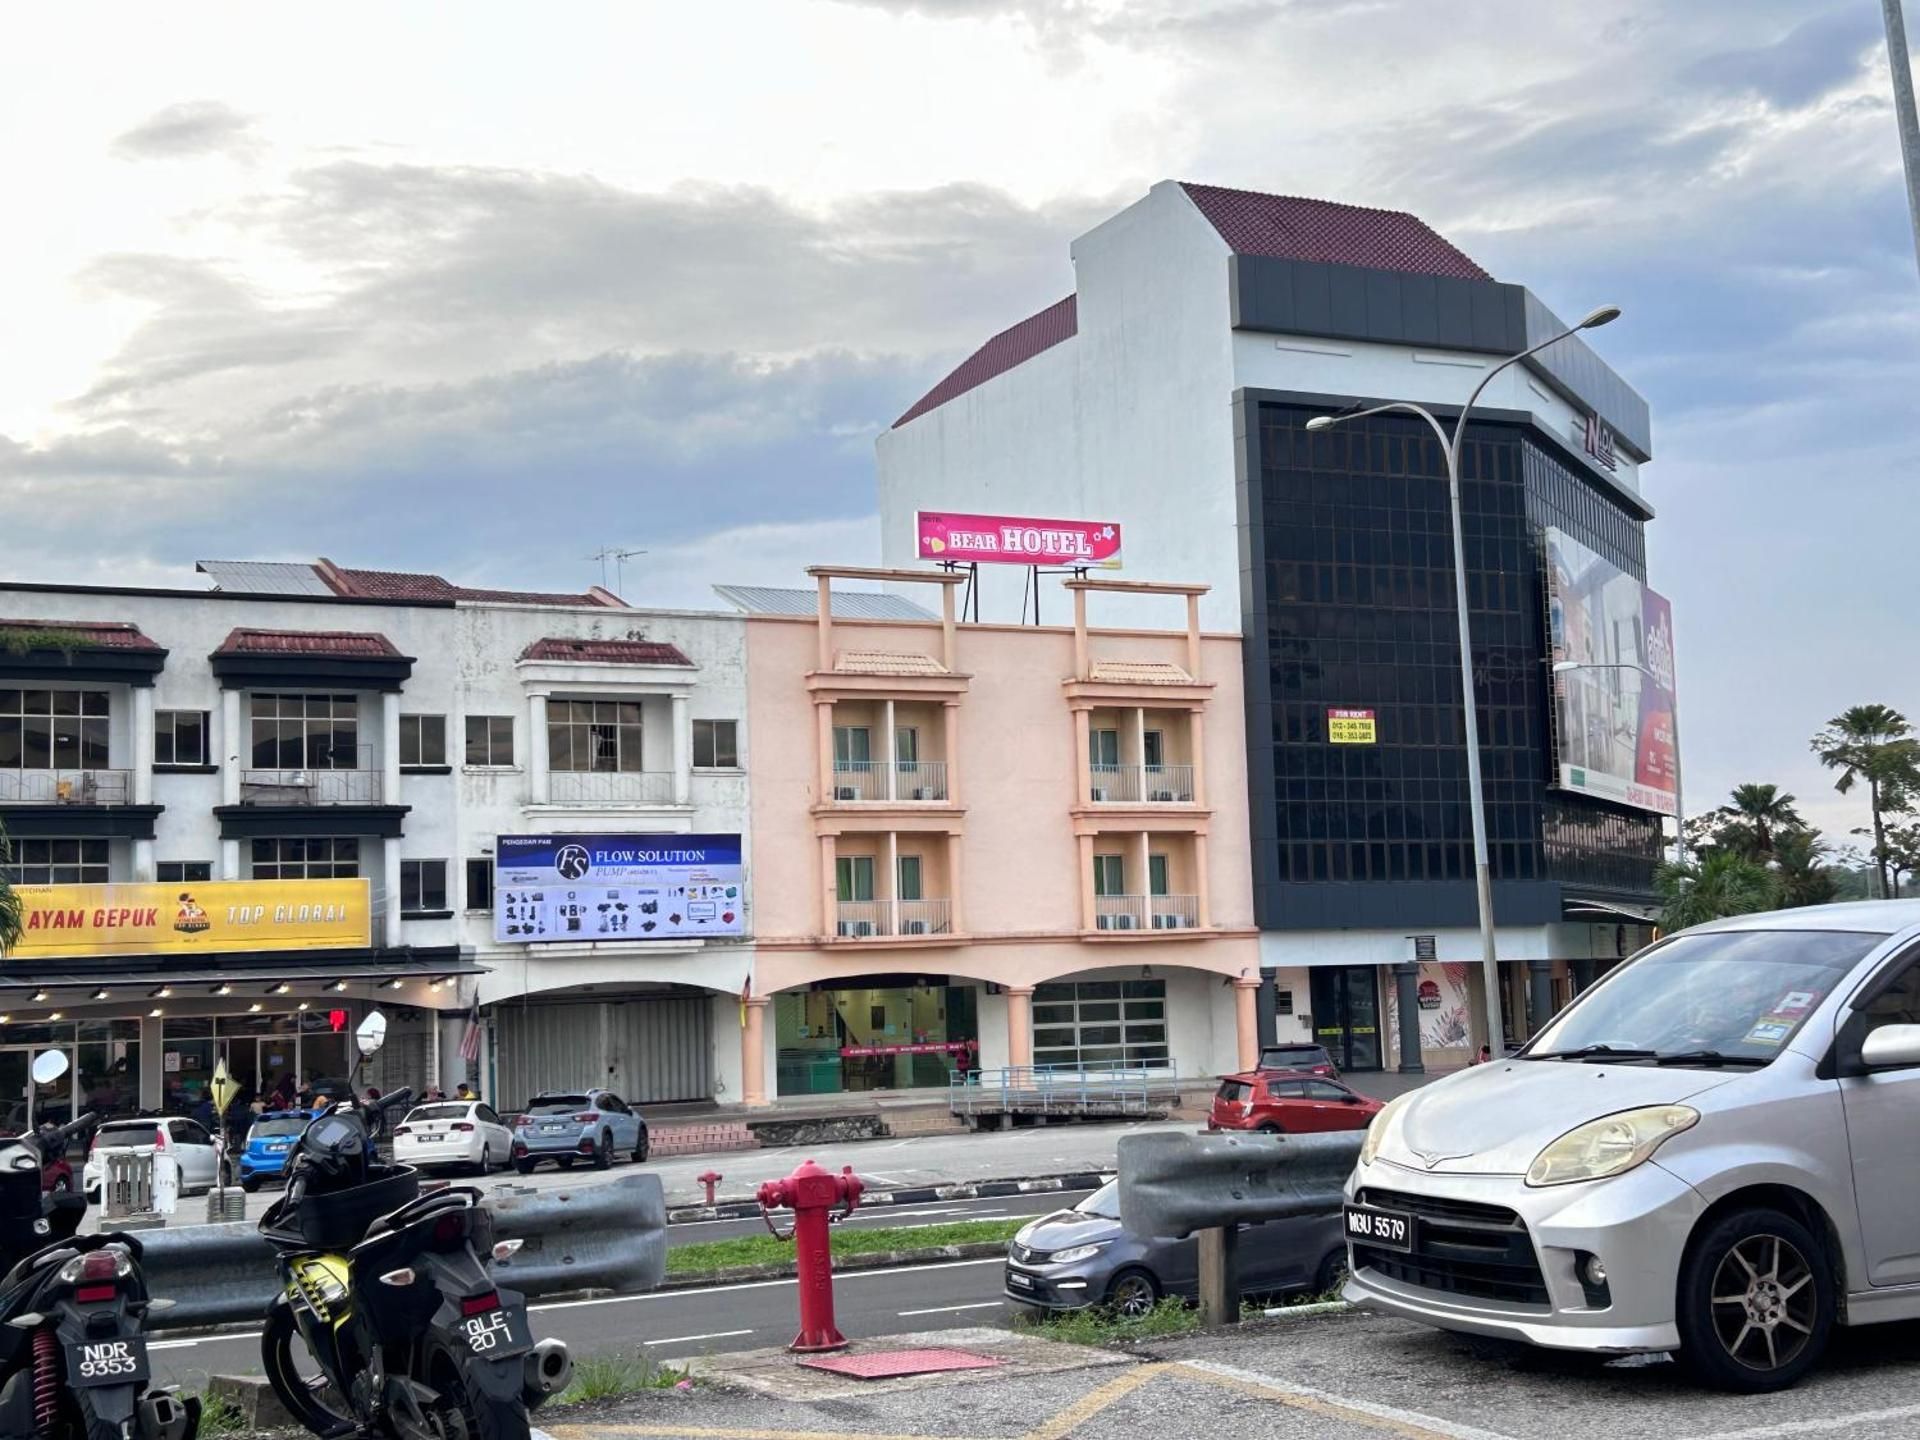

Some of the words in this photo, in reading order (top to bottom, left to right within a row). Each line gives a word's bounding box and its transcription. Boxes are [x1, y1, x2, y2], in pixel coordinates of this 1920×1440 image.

[950, 533, 998, 550] BEAR
[1001, 527, 1092, 556] HOTEL
[1335, 710, 1348, 718] FOR
[1350, 710, 1367, 718] RENT
[596, 850, 635, 862] FLOW
[638, 850, 705, 862] SOLUTION
[28, 909, 86, 930] AYAM
[93, 908, 159, 928] GEPUK
[227, 904, 266, 925] TOP
[274, 904, 347, 924] GLOBAL
[1375, 1216, 1405, 1240] 5579
[467, 1312, 506, 1335] QLE
[84, 1341, 128, 1361] NDR
[80, 1356, 137, 1377] 9353
